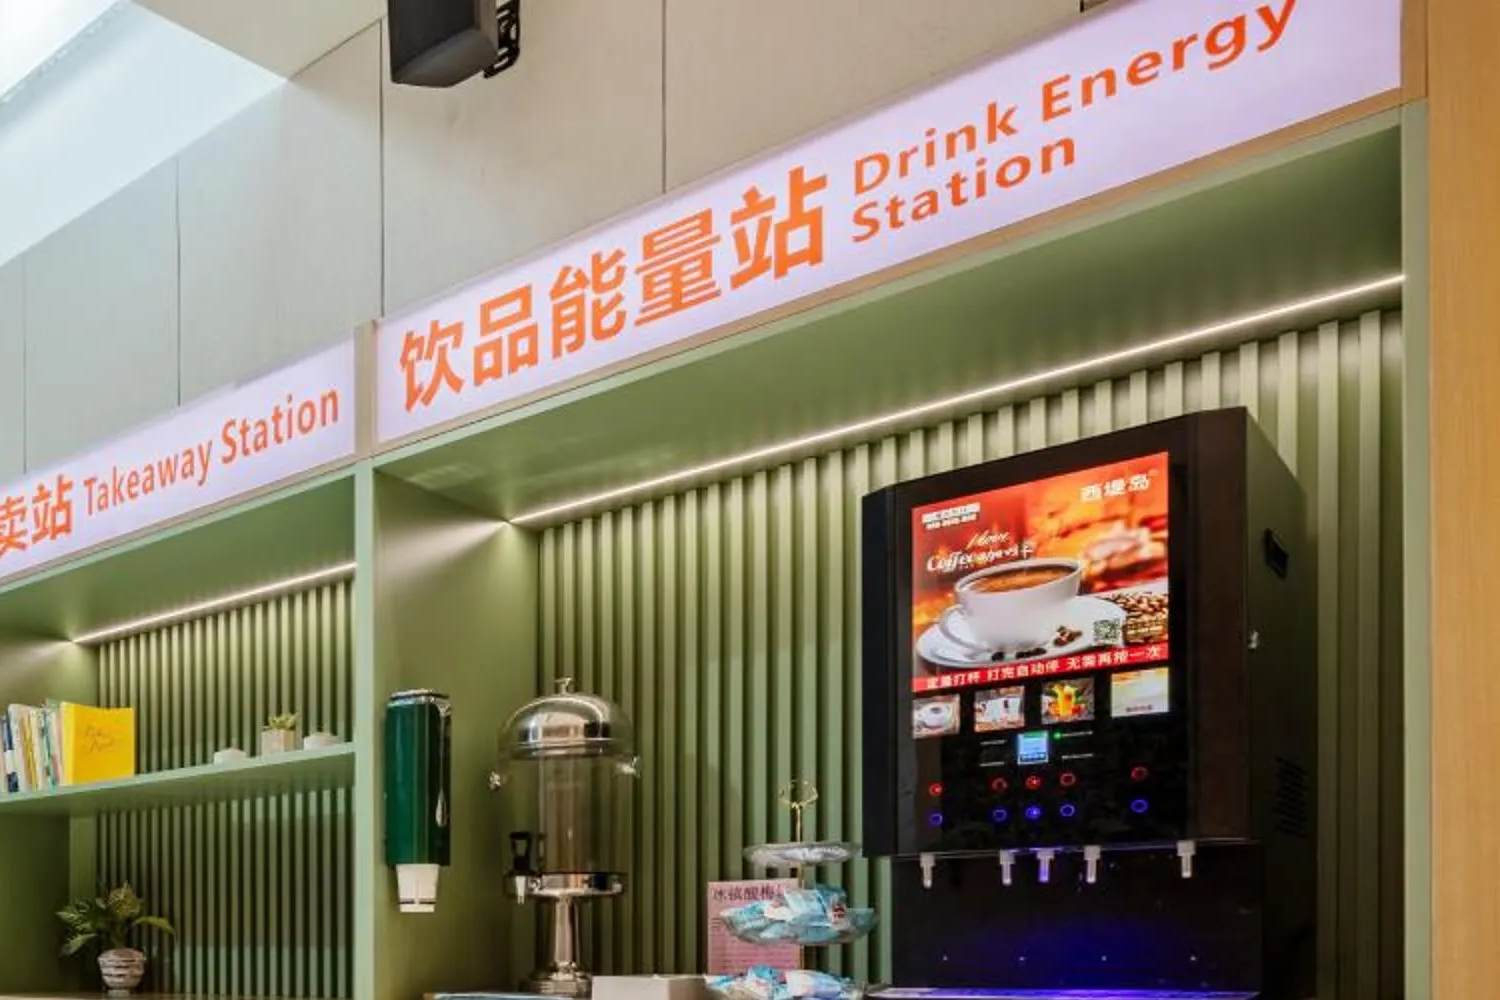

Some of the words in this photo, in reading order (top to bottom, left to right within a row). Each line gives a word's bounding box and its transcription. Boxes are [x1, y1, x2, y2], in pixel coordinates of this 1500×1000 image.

[854, 101, 1018, 196] Drink
[1041, 0, 1297, 122] Energy
[852, 137, 1076, 243] Station
[398, 165, 830, 413] 饮品能量站
[83, 440, 214, 516] Takeaway
[220, 387, 340, 466] Station
